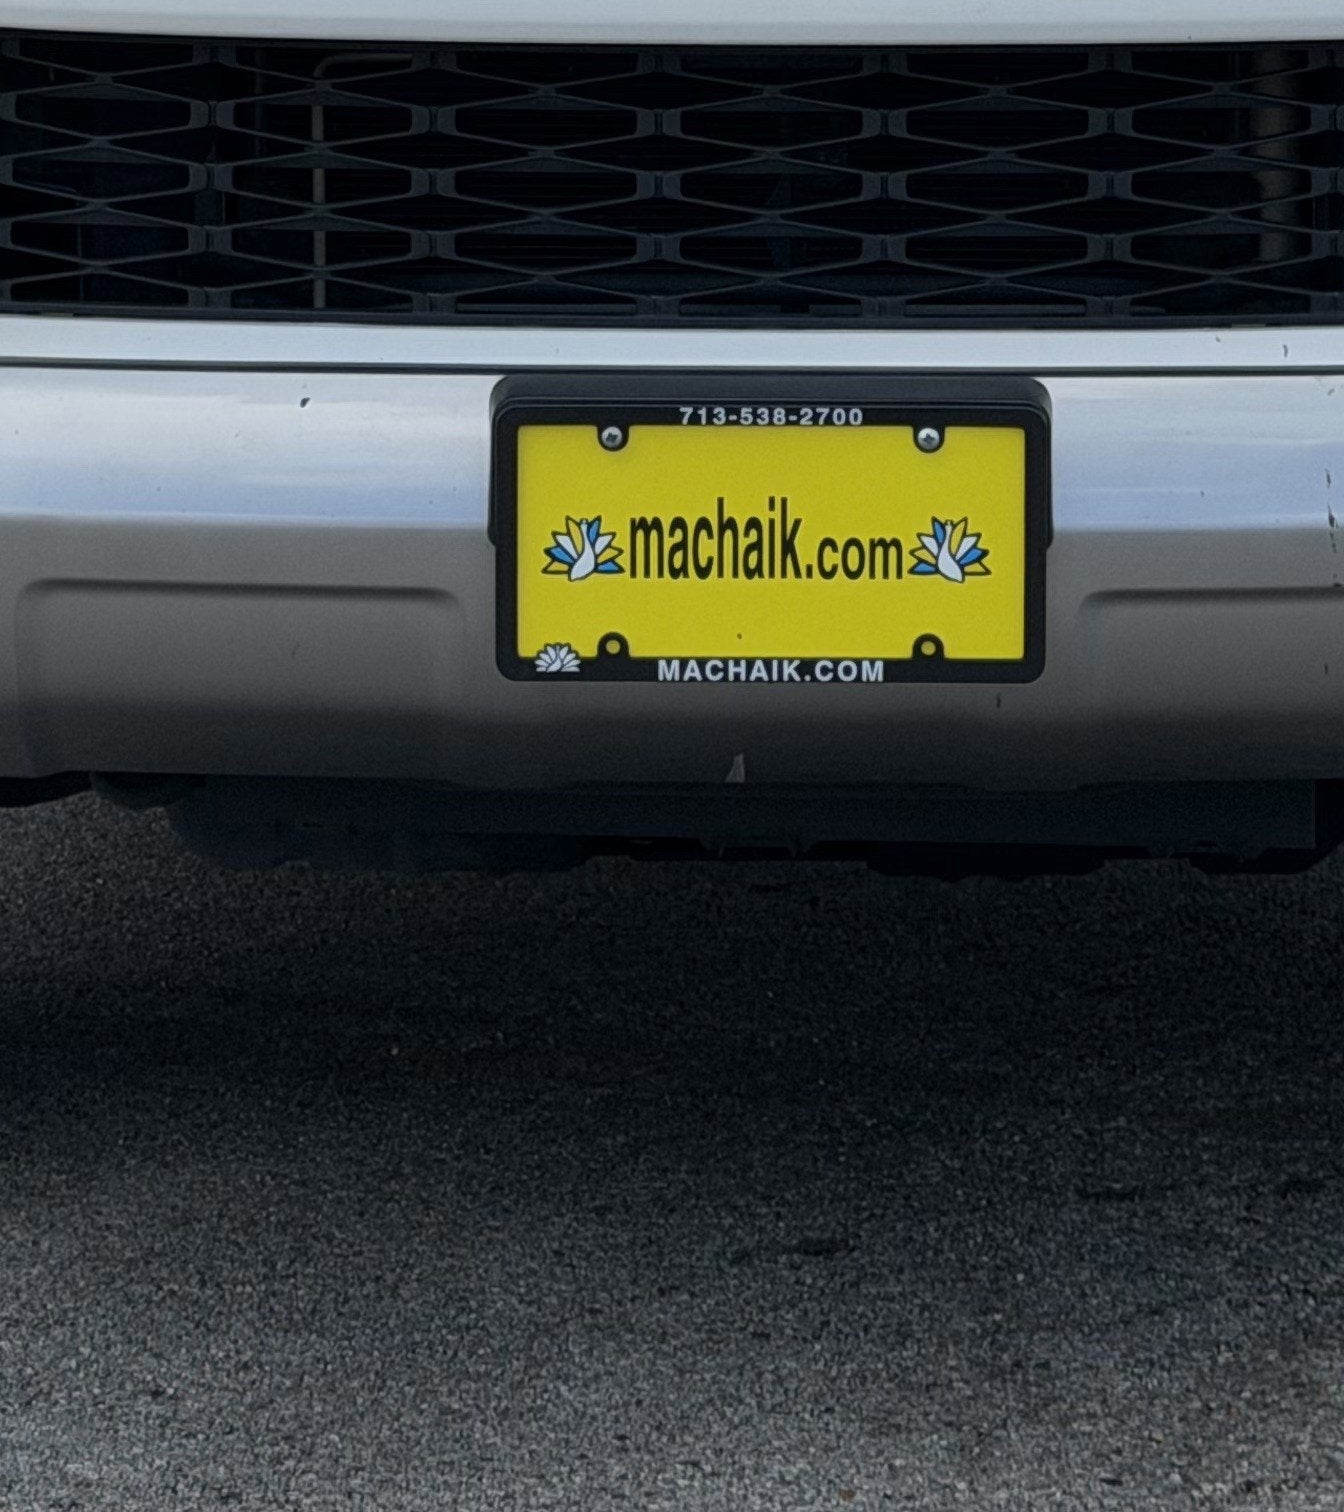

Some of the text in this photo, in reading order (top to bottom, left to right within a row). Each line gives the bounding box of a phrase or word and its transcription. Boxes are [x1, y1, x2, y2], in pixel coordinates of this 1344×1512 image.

[679, 406, 864, 427] 713-538-2700
[629, 496, 904, 580] machaik.com
[657, 659, 885, 683] MACHAIK.COM
